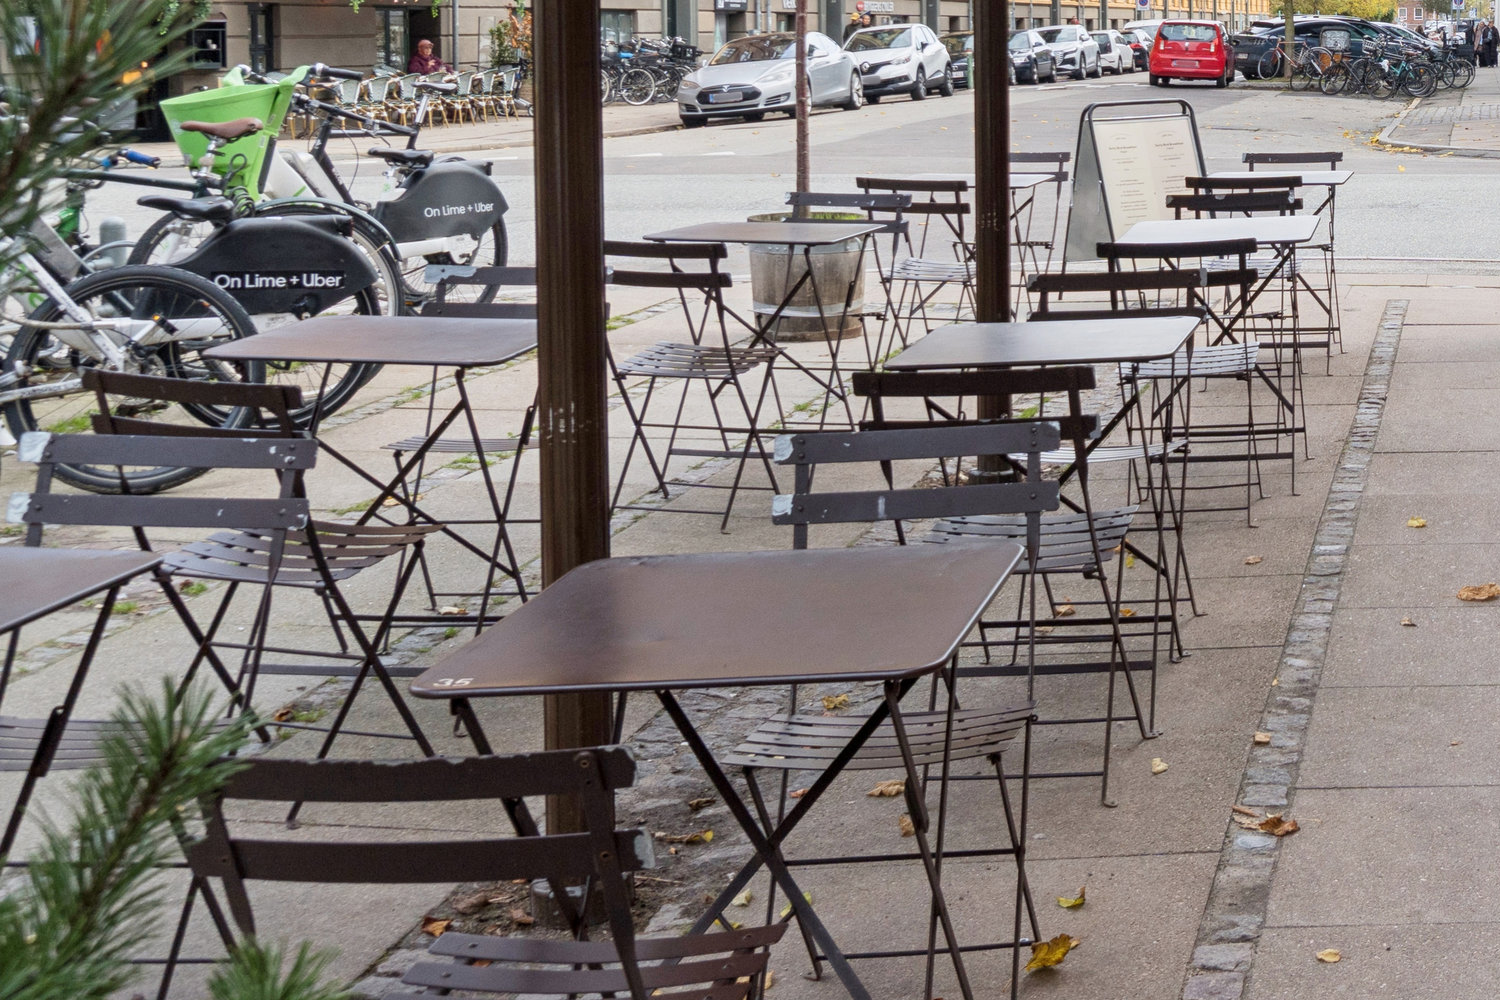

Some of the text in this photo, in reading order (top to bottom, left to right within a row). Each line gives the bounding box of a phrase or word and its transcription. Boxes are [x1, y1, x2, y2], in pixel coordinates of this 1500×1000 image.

[424, 207, 440, 218] On
[443, 205, 465, 217] Lime
[475, 202, 494, 214] Uber
[214, 272, 342, 289] On Lime + Uber
[433, 678, 474, 687] 35
